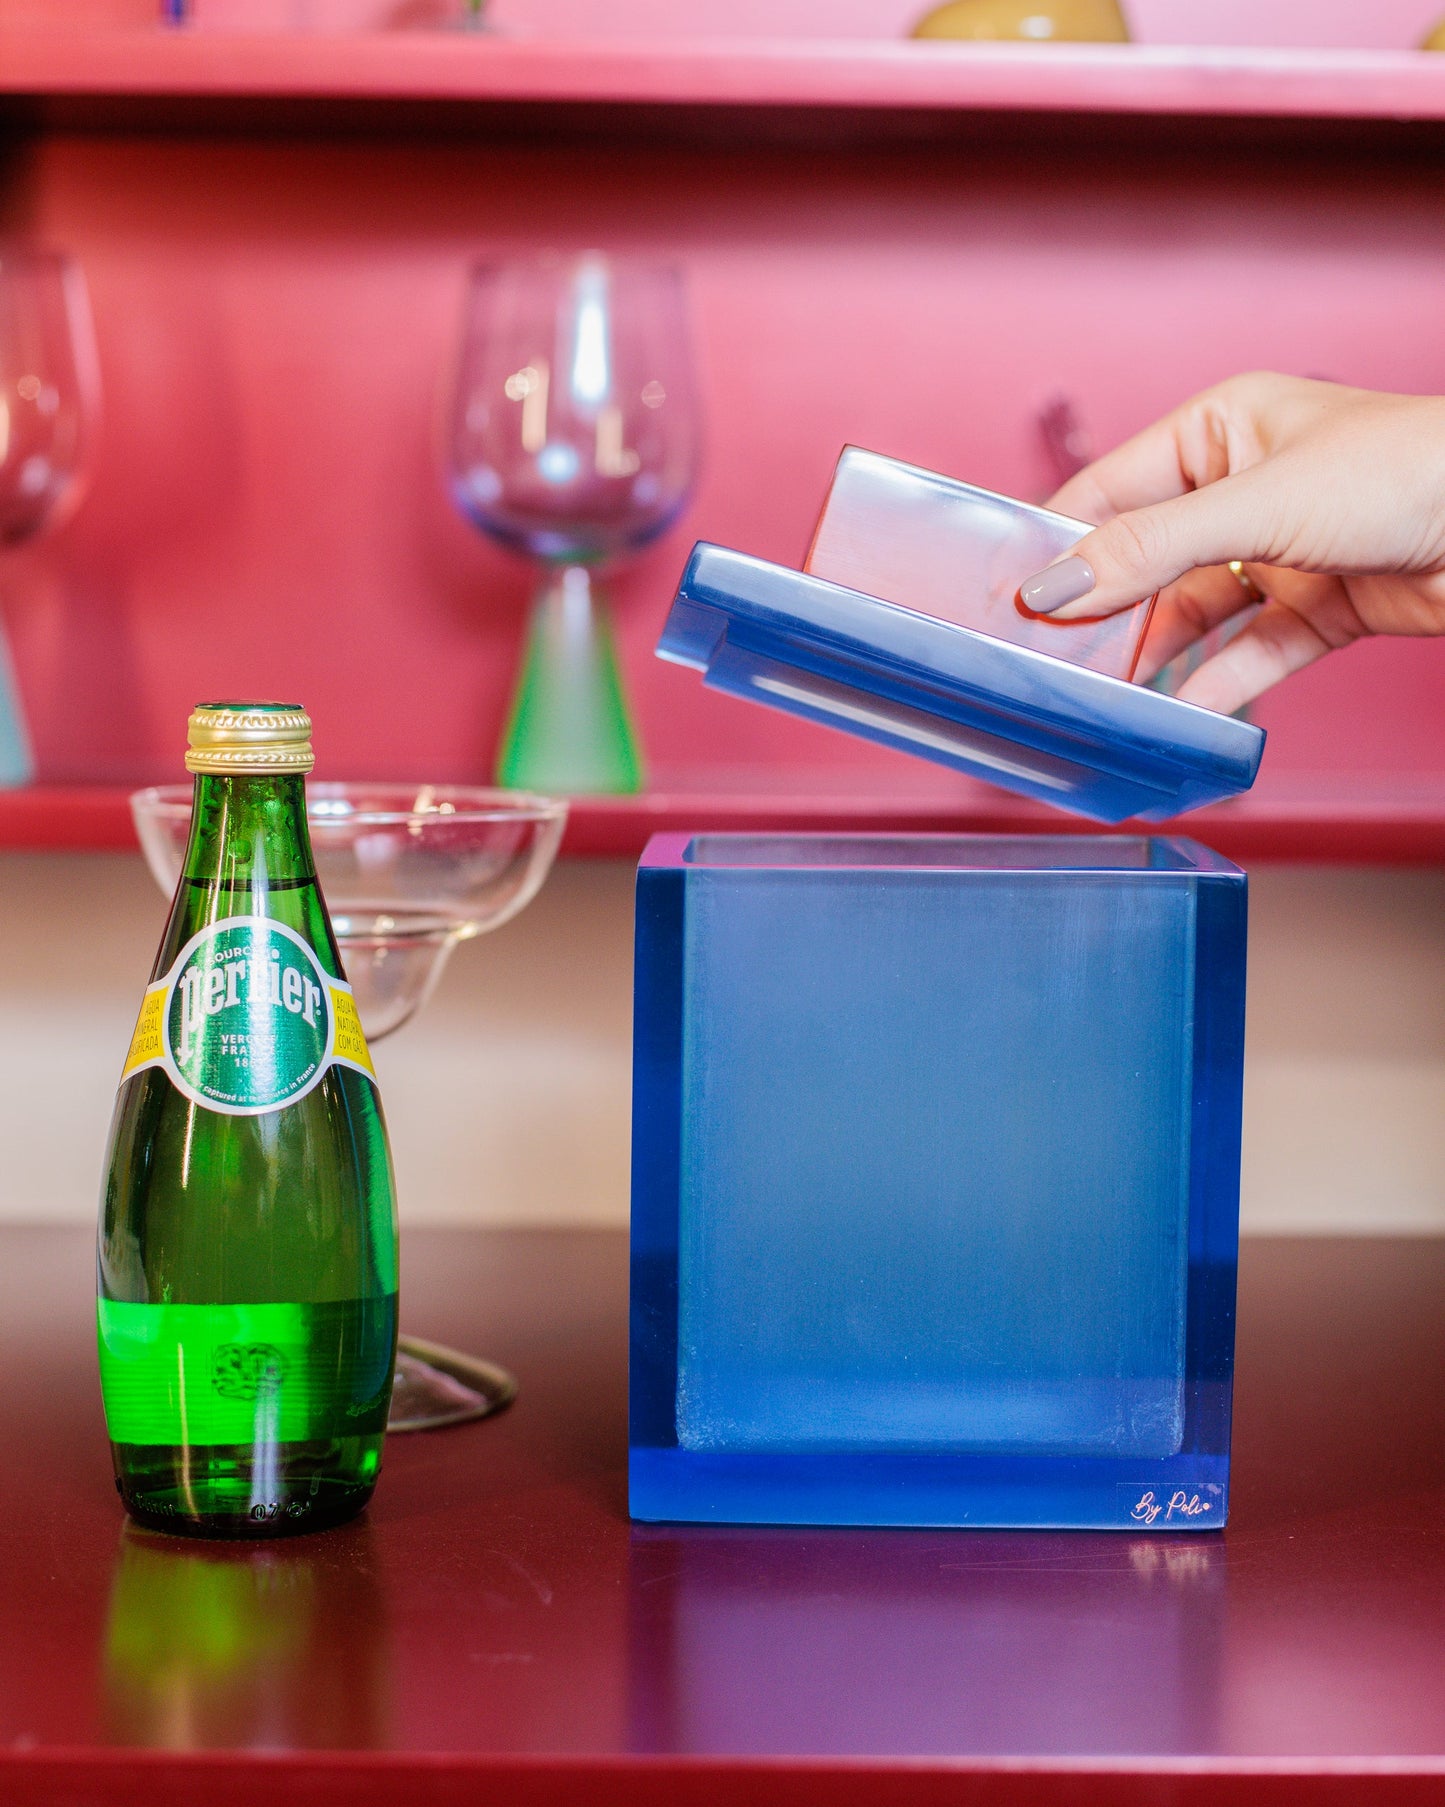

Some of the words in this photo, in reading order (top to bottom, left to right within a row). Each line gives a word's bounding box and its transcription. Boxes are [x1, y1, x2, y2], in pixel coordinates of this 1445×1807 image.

[209, 946, 262, 967] OURC
[137, 1017, 158, 1035] NERAL
[220, 1044, 275, 1056] FRAE
[203, 1085, 237, 1102] captured
[289, 1081, 298, 1090] in
[296, 1062, 316, 1085] France
[1130, 1491, 1162, 1524] By
